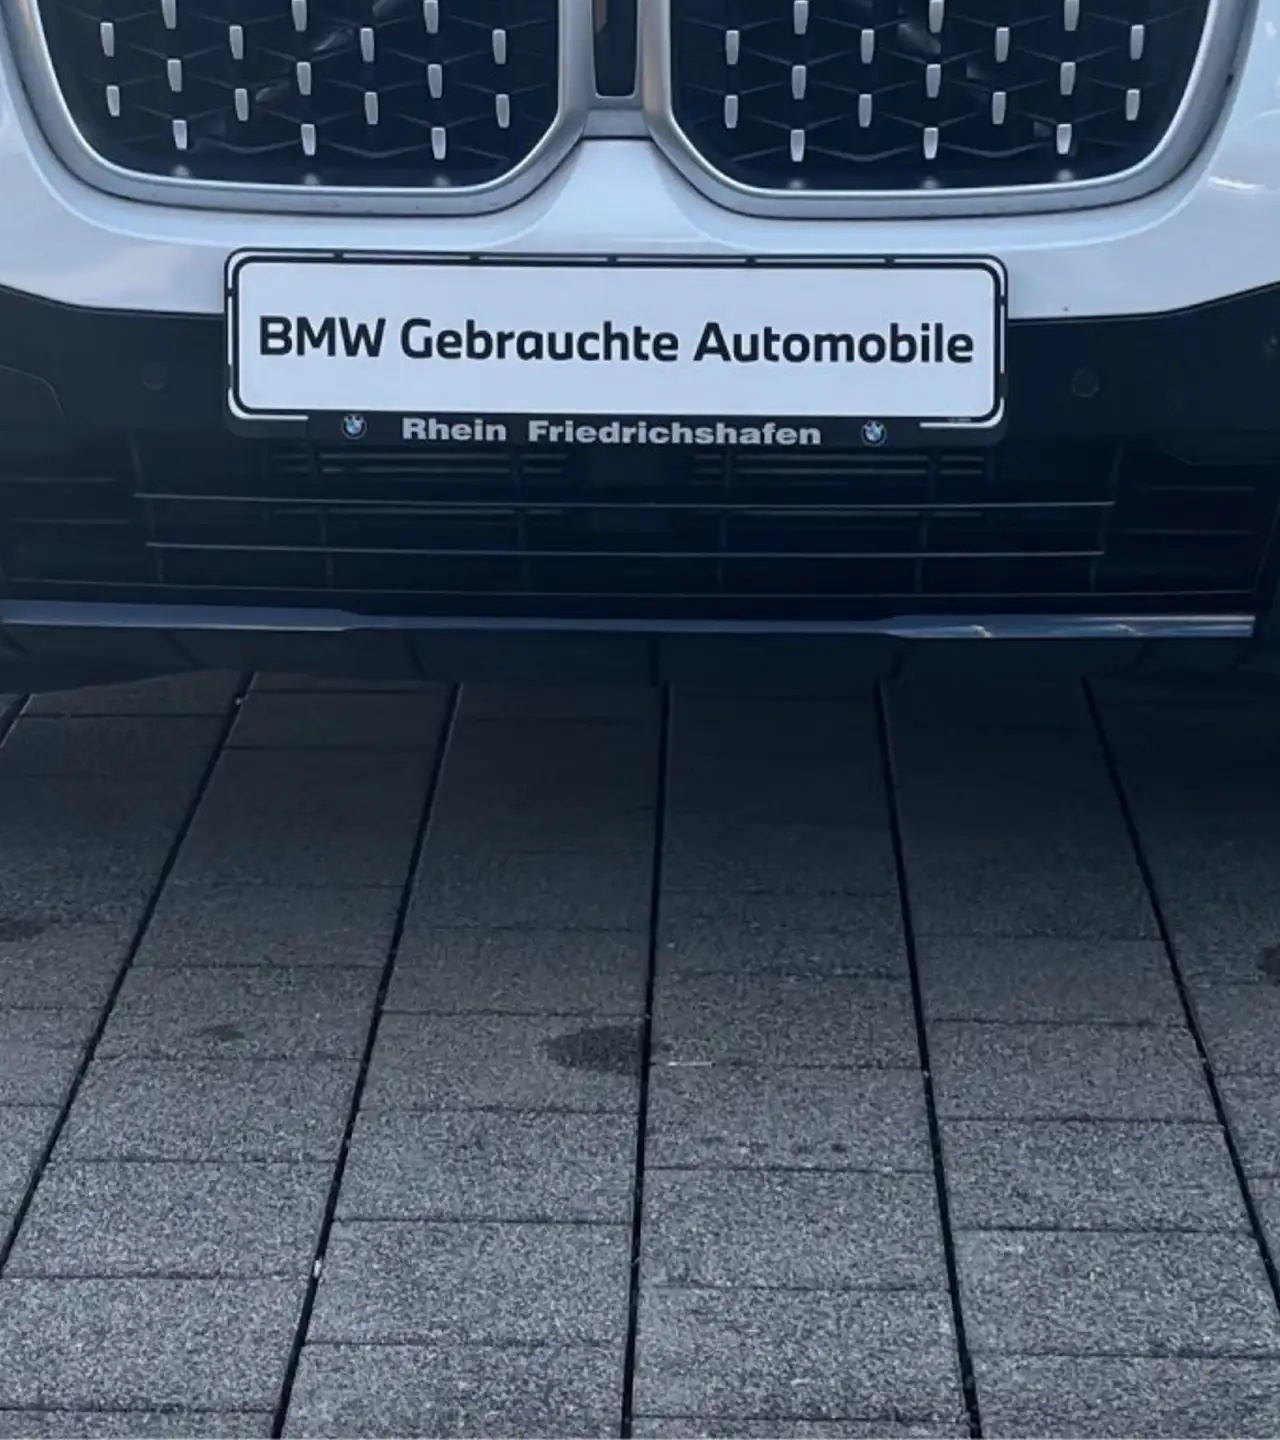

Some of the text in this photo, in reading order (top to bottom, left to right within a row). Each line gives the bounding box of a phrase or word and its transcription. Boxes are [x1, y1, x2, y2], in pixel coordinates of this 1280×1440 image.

[259, 315, 973, 363] BMW Gebrauchte Automobile
[402, 417, 821, 445] Rhein Friedrichshafen
